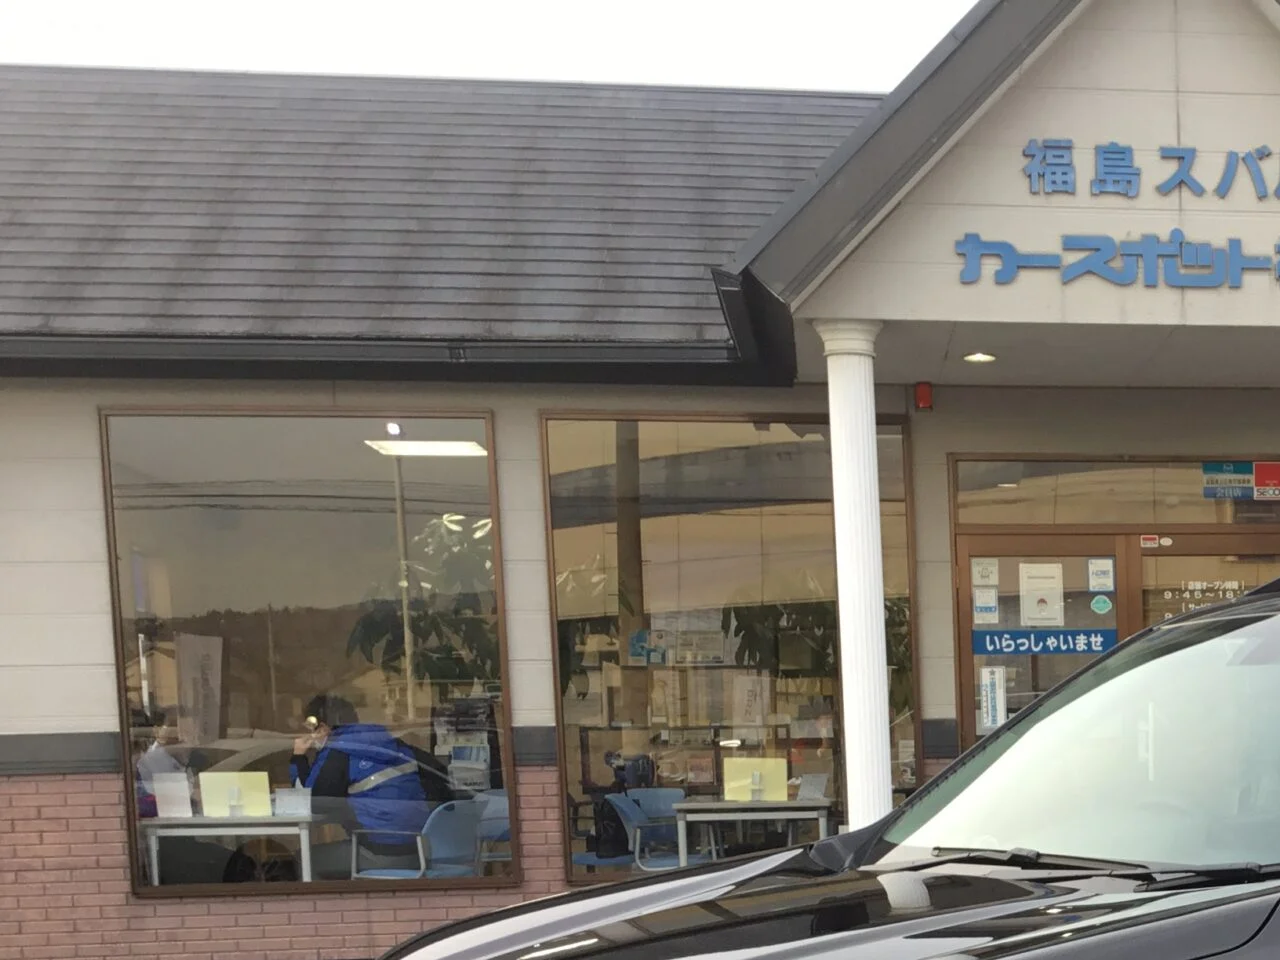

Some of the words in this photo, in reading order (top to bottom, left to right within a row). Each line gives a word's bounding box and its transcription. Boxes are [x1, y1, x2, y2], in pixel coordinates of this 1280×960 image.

[986, 634, 1104, 652] いらっしゃいませ
